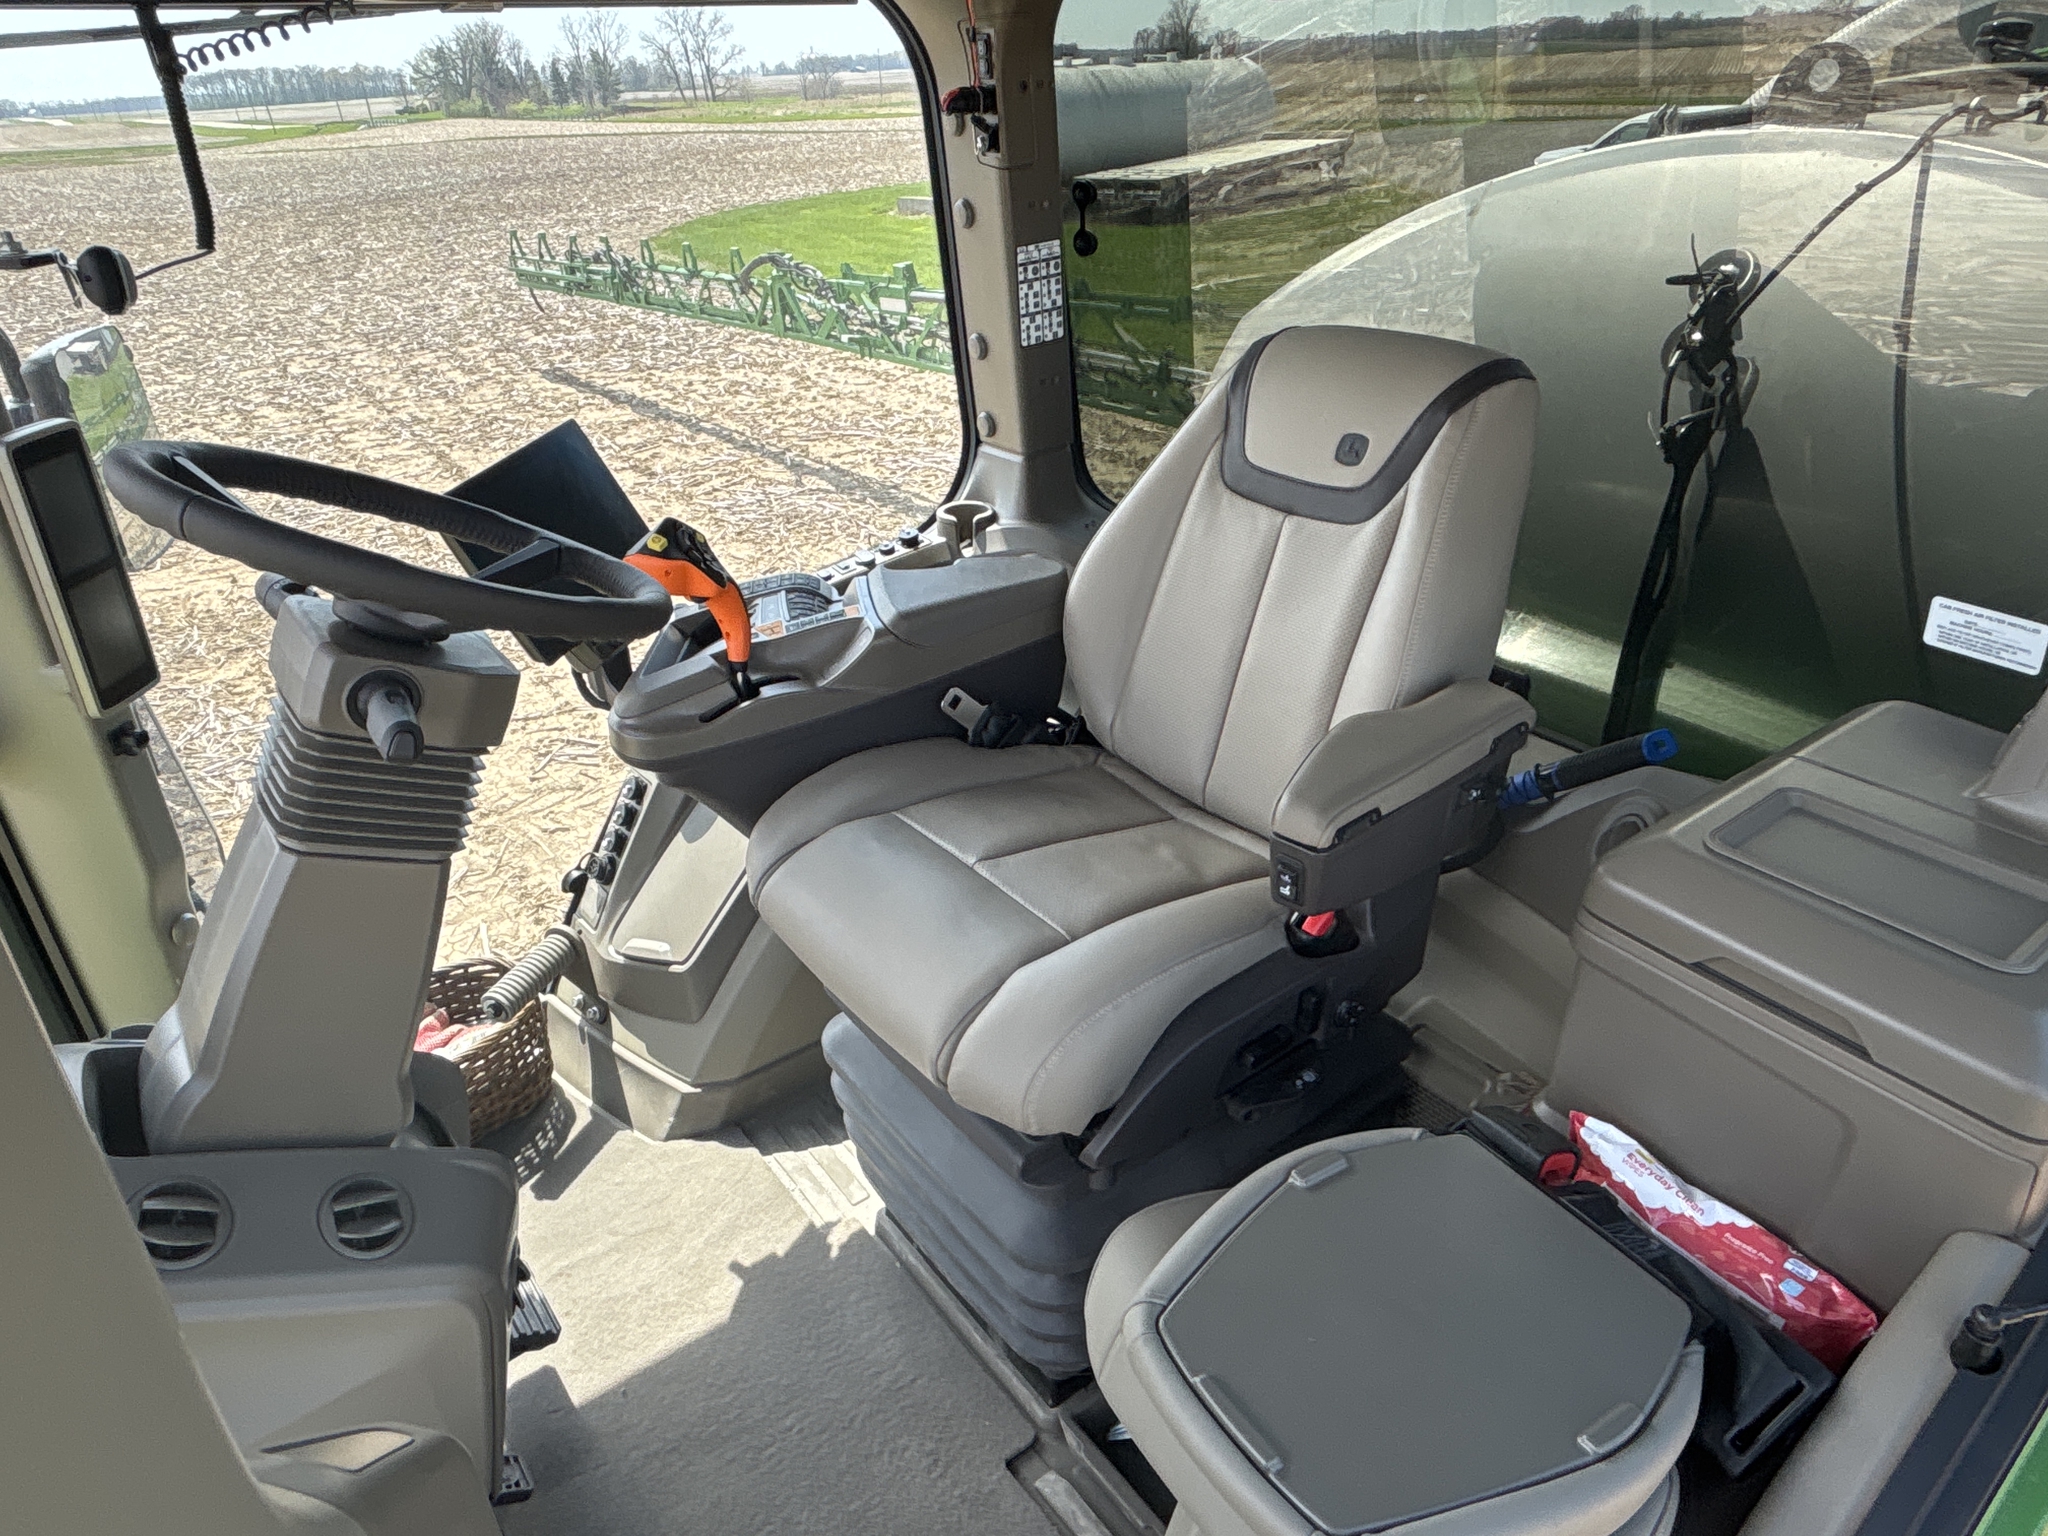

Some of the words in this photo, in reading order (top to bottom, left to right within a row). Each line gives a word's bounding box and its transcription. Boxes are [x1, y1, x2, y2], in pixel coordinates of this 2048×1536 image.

[1985, 615, 2006, 625] FILTER
[2007, 621, 2041, 634] INSTALLED
[1626, 1152, 1675, 1190] Everyday
[1675, 1189, 1705, 1216] Clean
[1757, 1251, 1774, 1264] Free
